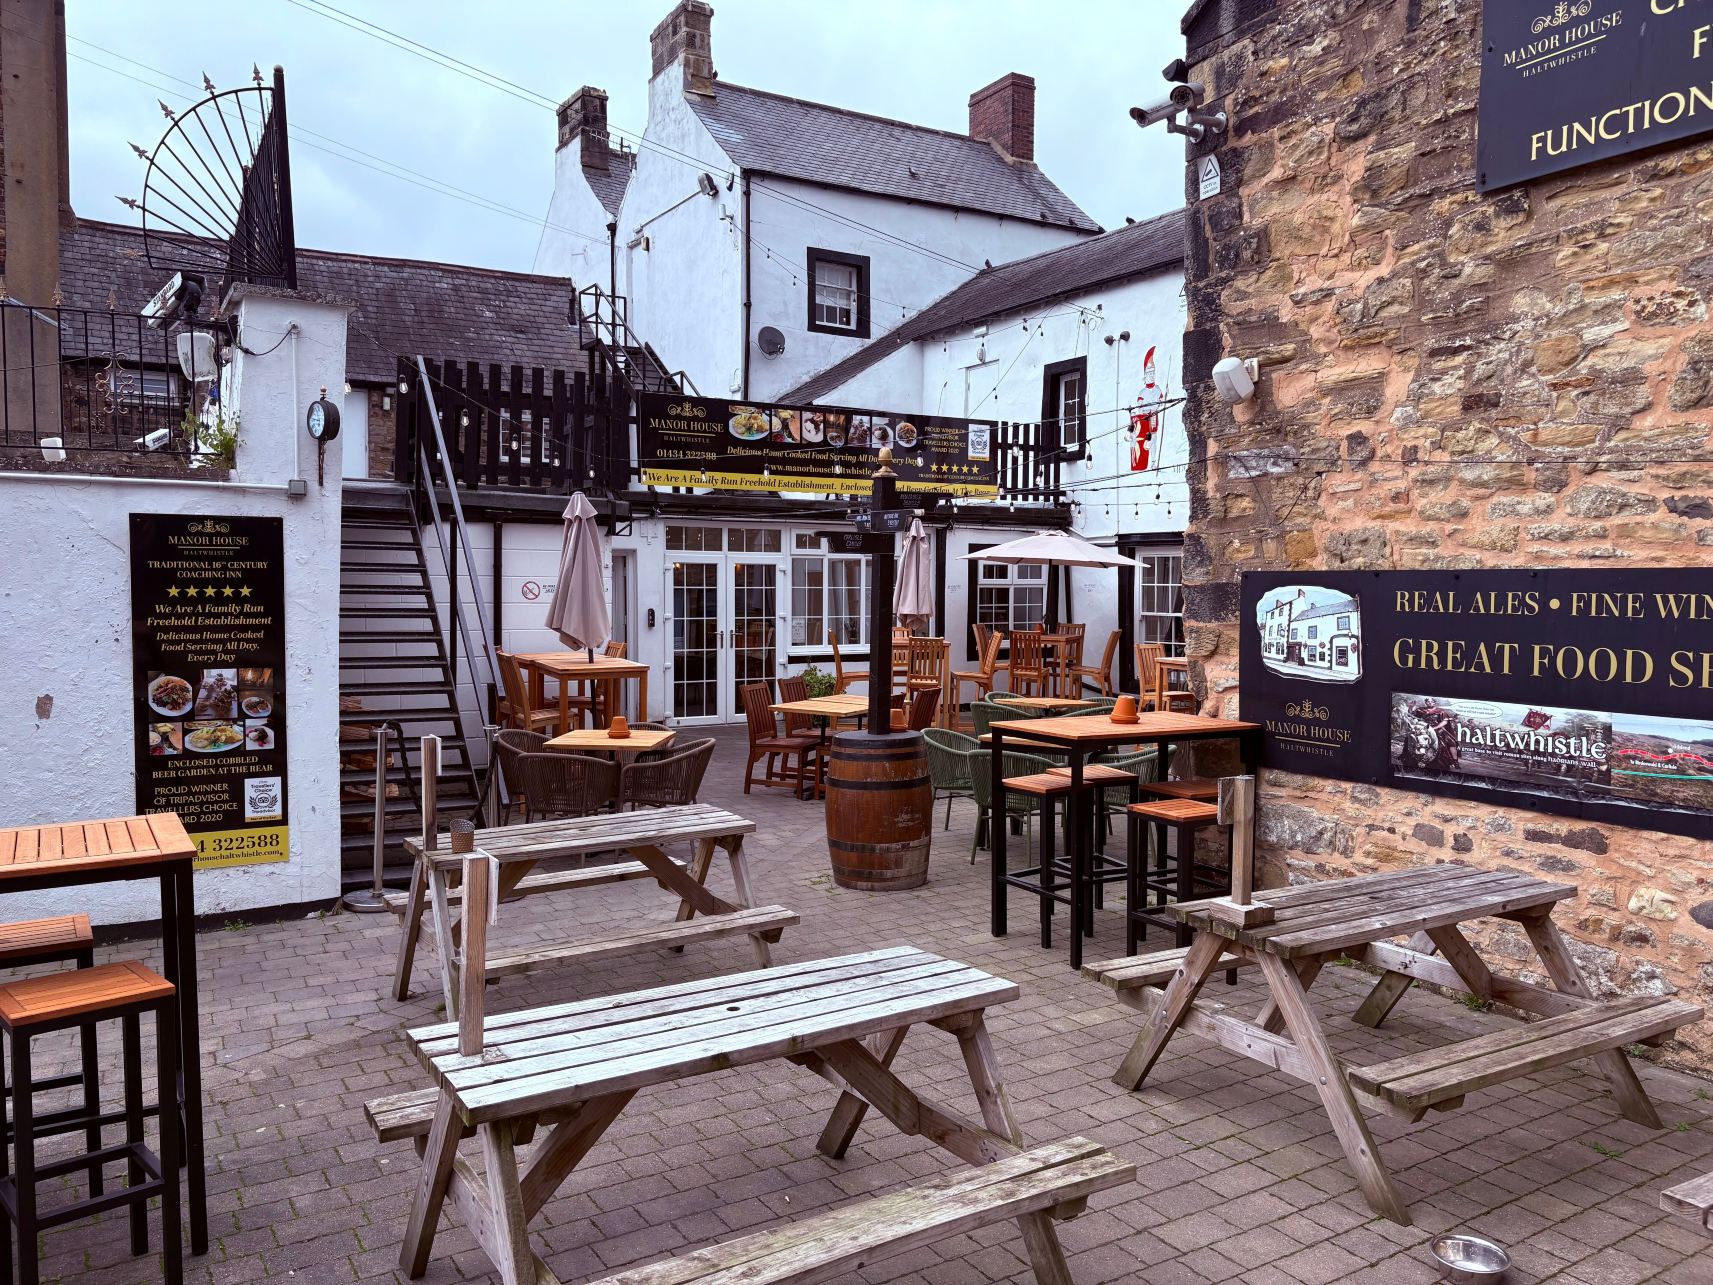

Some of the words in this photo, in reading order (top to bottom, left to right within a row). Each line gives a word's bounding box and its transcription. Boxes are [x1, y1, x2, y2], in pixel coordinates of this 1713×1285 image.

[1503, 35, 1559, 67] MANOR
[1565, 10, 1622, 44] HOUSE
[1692, 24, 1713, 59] F
[1523, 46, 1597, 78] HALTWHISTLE
[1530, 80, 1713, 161] FUNCTION
[649, 418, 688, 430] MANOR
[690, 421, 725, 433] HOUSE
[663, 435, 710, 444] HALTWHISTLE
[656, 448, 684, 459] 01434
[727, 445, 762, 456] Delicious
[784, 449, 811, 460] Cooked
[811, 451, 829, 461] Food
[829, 453, 857, 464] Serving
[858, 454, 867, 463] All
[648, 473, 662, 482] We
[663, 473, 680, 482] Are
[681, 474, 687, 483] A
[689, 475, 719, 487] Faily
[720, 477, 738, 486] Run
[739, 477, 777, 488] Freehold
[777, 480, 837, 491] Establishment.
[168, 536, 210, 545] MANOR
[212, 536, 249, 546] HOUSE
[147, 561, 211, 569] TRADITIONAL
[227, 561, 268, 569] CENTURY
[177, 570, 225, 579] COACHING
[226, 570, 242, 578] INN
[155, 605, 172, 613] We
[174, 604, 193, 613] Are
[195, 604, 203, 613] A
[204, 604, 242, 615] Family
[243, 604, 264, 613] Run
[1395, 590, 1462, 613] REAL
[1469, 591, 1540, 615] ALES
[1570, 592, 1645, 618] FINE
[147, 616, 196, 627] Freehold
[197, 616, 272, 626] Establishment
[156, 632, 201, 641] Delicious
[202, 632, 229, 640] Home
[231, 631, 264, 640] Cooked
[161, 643, 185, 652] Food
[186, 643, 223, 653] Serving
[224, 642, 238, 650] All
[187, 653, 215, 663] Every
[217, 652, 236, 663] Day
[1393, 637, 1519, 675] GREAT
[1530, 644, 1654, 684] FOOD
[1266, 719, 1307, 736] MANOR
[1310, 727, 1351, 743] HOUSE
[1456, 723, 1607, 759] haltwhistle
[1280, 743, 1334, 757] HALTWHISTLE
[168, 758, 216, 768] ENCLOSED
[217, 755, 259, 765] COBBLED
[152, 769, 177, 779] BEER
[178, 767, 216, 778] GARDEN
[216, 767, 229, 775] AT
[229, 766, 249, 774] THE
[249, 764, 273, 773] REAR
[154, 785, 189, 795] PROUD
[190, 783, 229, 793] WINNER
[153, 796, 168, 806] OF
[169, 793, 230, 804] TRIPADVISOR
[144, 804, 201, 815] TRAVELLERS
[202, 802, 239, 812] CHOICE
[179, 814, 197, 824] ARD
[200, 813, 223, 822] 2020
[212, 833, 280, 852] 322588
[192, 848, 280, 863] rhousehaltwhistle.com
